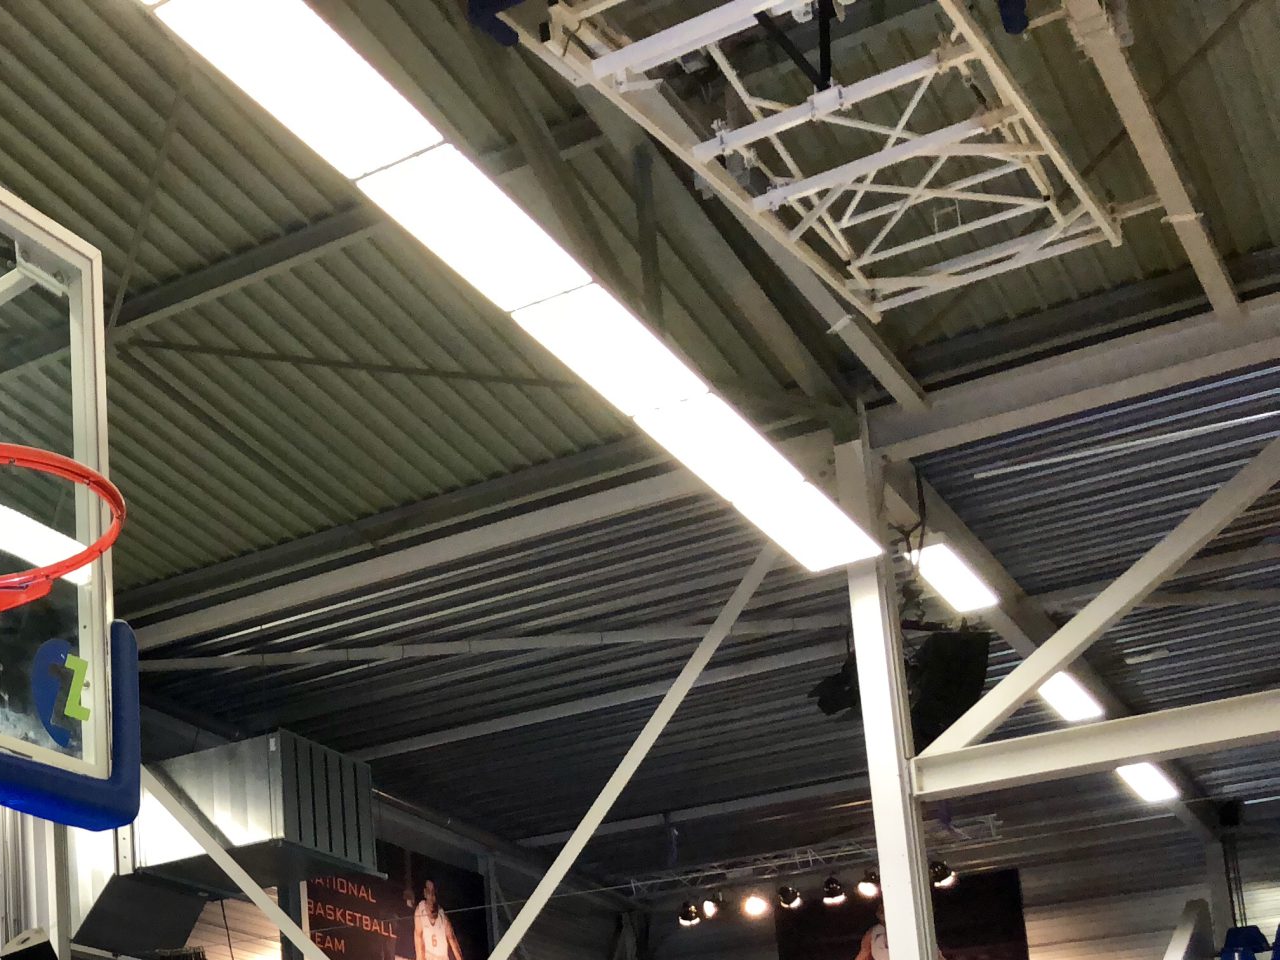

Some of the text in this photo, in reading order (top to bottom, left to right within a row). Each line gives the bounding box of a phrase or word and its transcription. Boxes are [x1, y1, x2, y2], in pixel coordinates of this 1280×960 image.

[310, 876, 376, 903] ATIONAL
[308, 899, 398, 938] BASKETBALL
[310, 932, 345, 954] EAM
